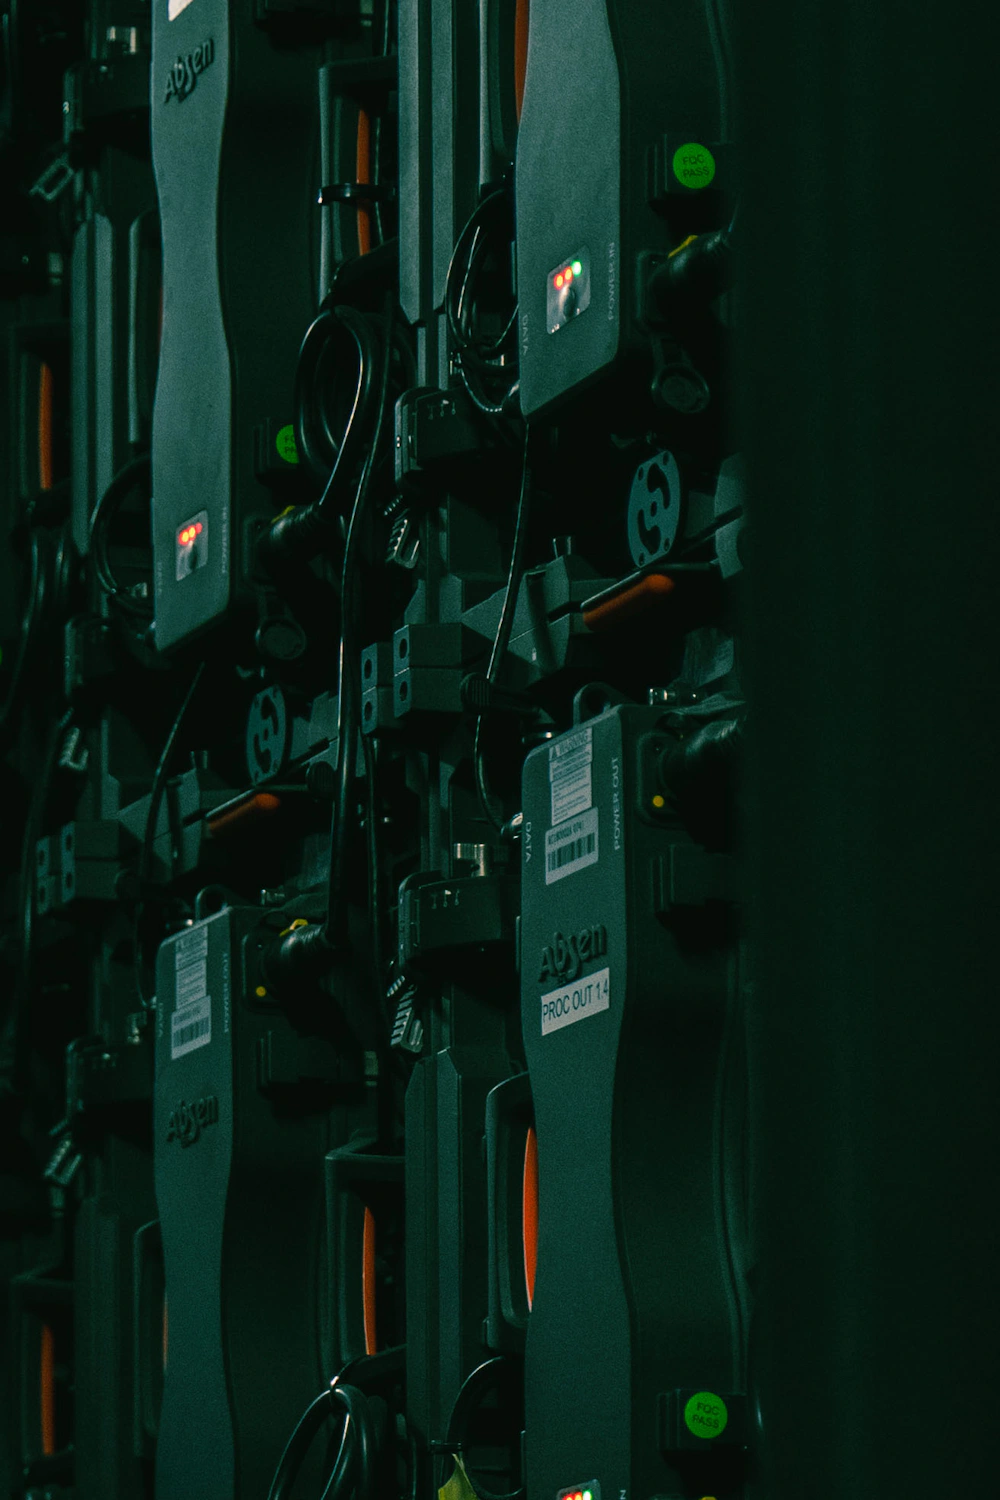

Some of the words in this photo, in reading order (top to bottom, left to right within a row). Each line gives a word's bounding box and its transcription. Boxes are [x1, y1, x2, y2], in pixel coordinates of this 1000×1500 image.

[164, 37, 214, 103] Absen
[682, 166, 710, 179] PASS
[607, 260, 616, 321] POWER
[611, 756, 620, 788] OUT
[612, 791, 621, 851] POWER
[540, 924, 607, 984] Absen
[543, 994, 571, 1022] PROC
[572, 984, 594, 1011] OUT
[166, 1095, 220, 1149] Absen
[691, 1413, 720, 1429] PASS
